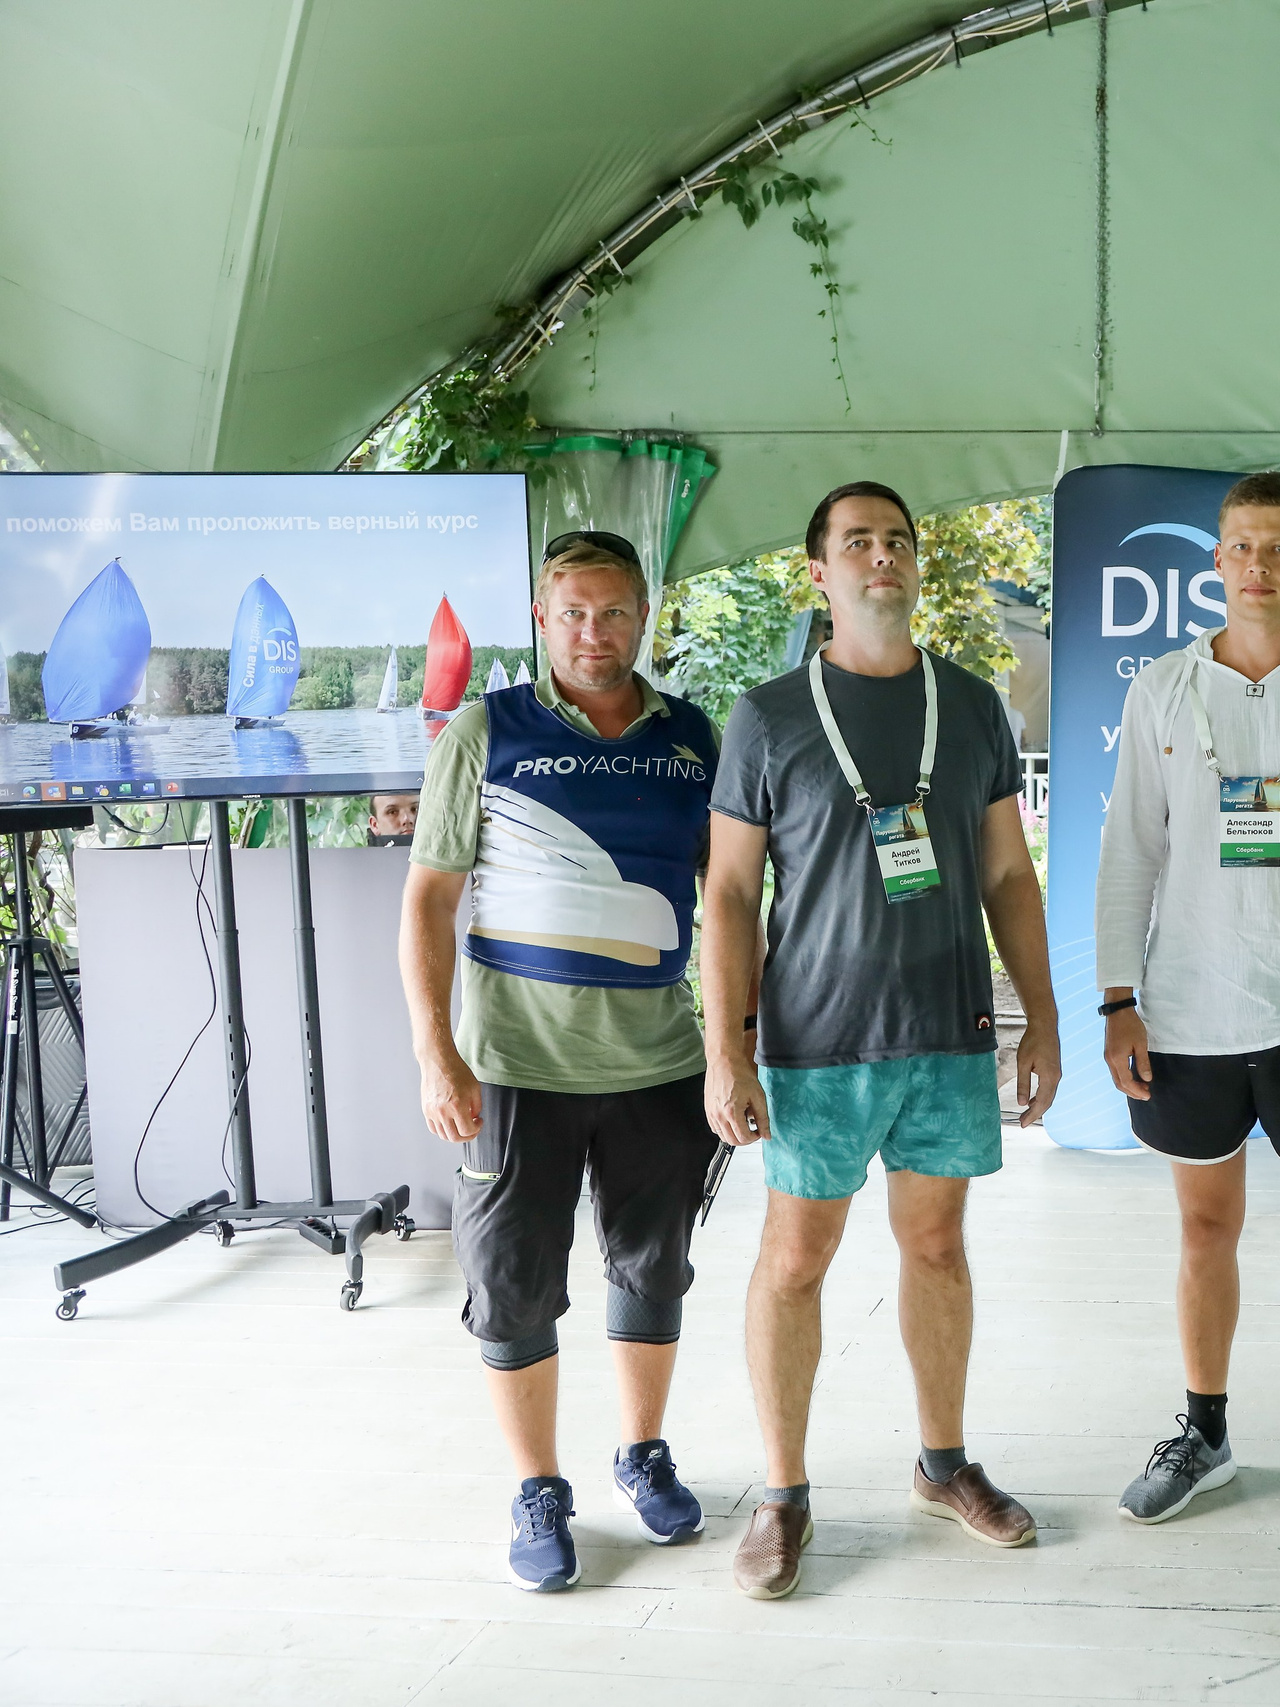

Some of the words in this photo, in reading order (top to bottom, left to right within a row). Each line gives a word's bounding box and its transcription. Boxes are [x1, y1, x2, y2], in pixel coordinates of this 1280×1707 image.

[6, 517, 122, 533] поможем
[129, 512, 180, 532] Вам
[187, 516, 321, 536] проложить
[328, 510, 419, 534] верный
[426, 514, 479, 534] курс
[1101, 566, 1227, 638] DIS
[250, 603, 264, 644] данных
[249, 645, 257, 655] в
[262, 639, 297, 662] DIS
[242, 656, 257, 688] Сила
[269, 666, 294, 674] GROUP
[513, 755, 707, 782] PROYACHTING
[1226, 819, 1273, 828] Александр
[1226, 828, 1273, 836] Бельтюков
[891, 847, 921, 859] Андрей
[894, 857, 922, 868] Титков
[899, 876, 925, 886] Сбербанк
